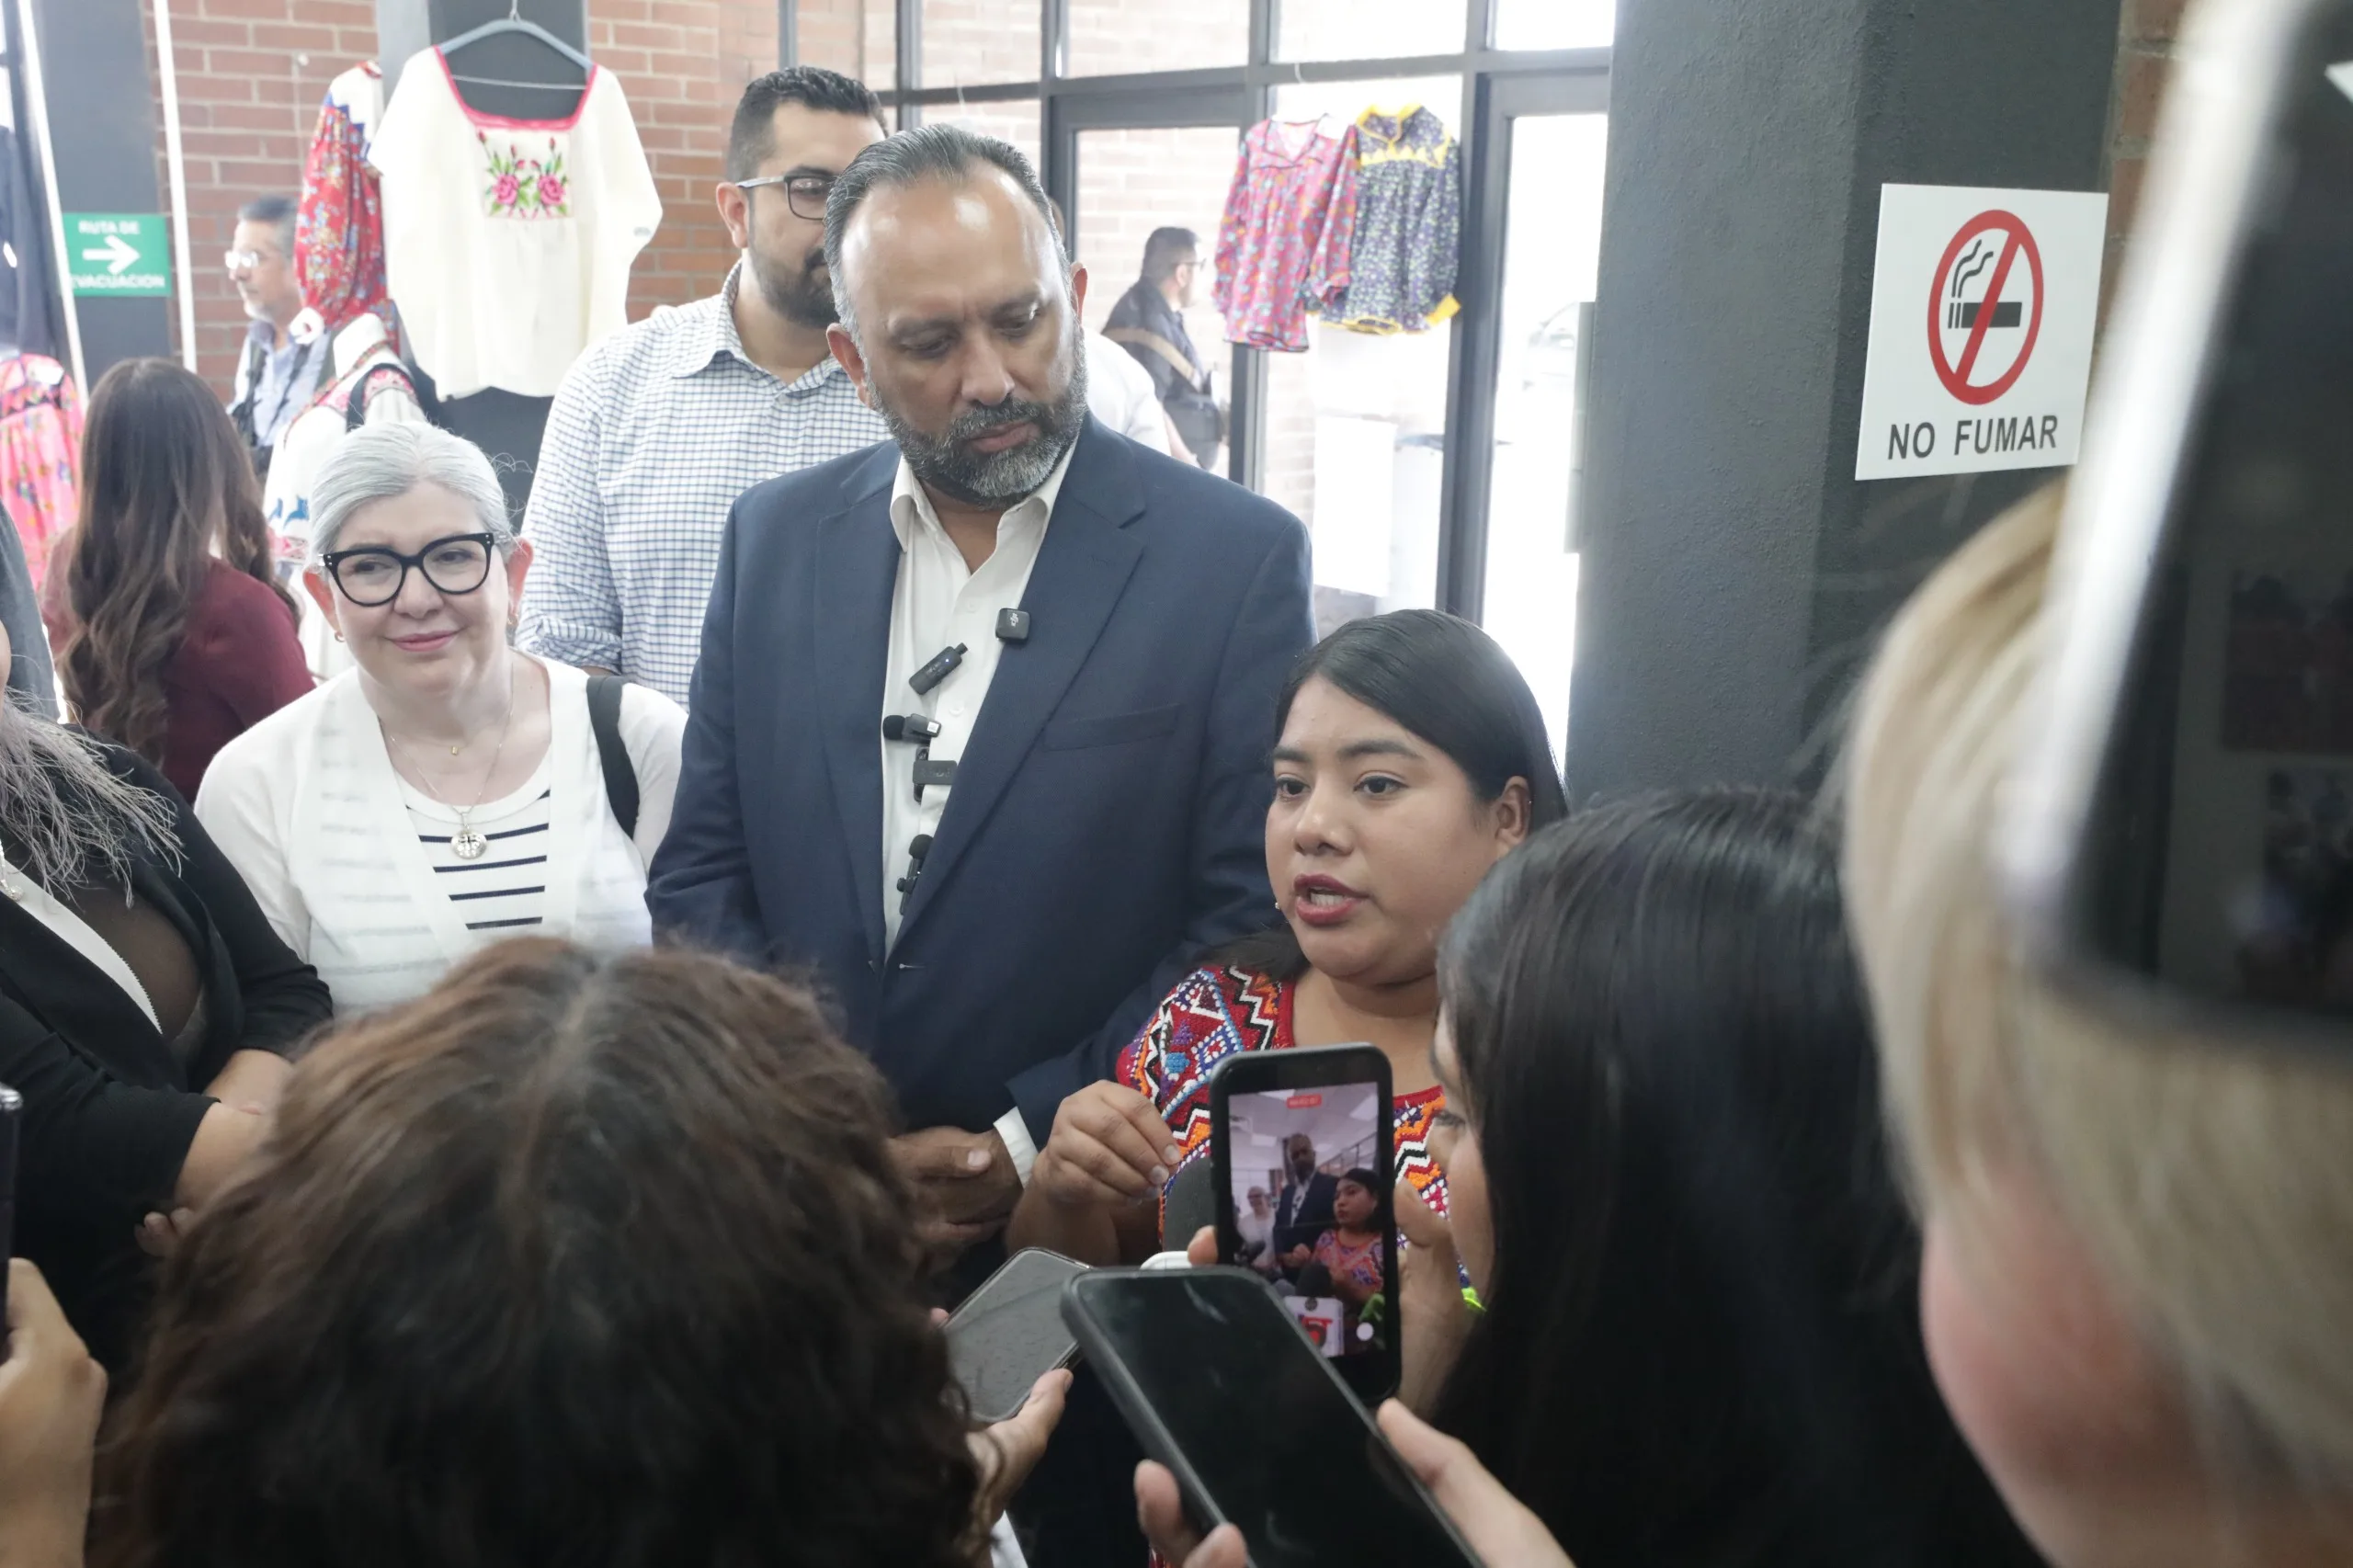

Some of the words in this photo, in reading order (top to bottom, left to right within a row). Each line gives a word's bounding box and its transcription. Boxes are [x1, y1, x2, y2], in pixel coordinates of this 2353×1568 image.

[78, 221, 117, 233] RUTA
[119, 221, 141, 234] DE
[1888, 422, 1936, 460] NO
[1954, 415, 2058, 456] FUMAR
